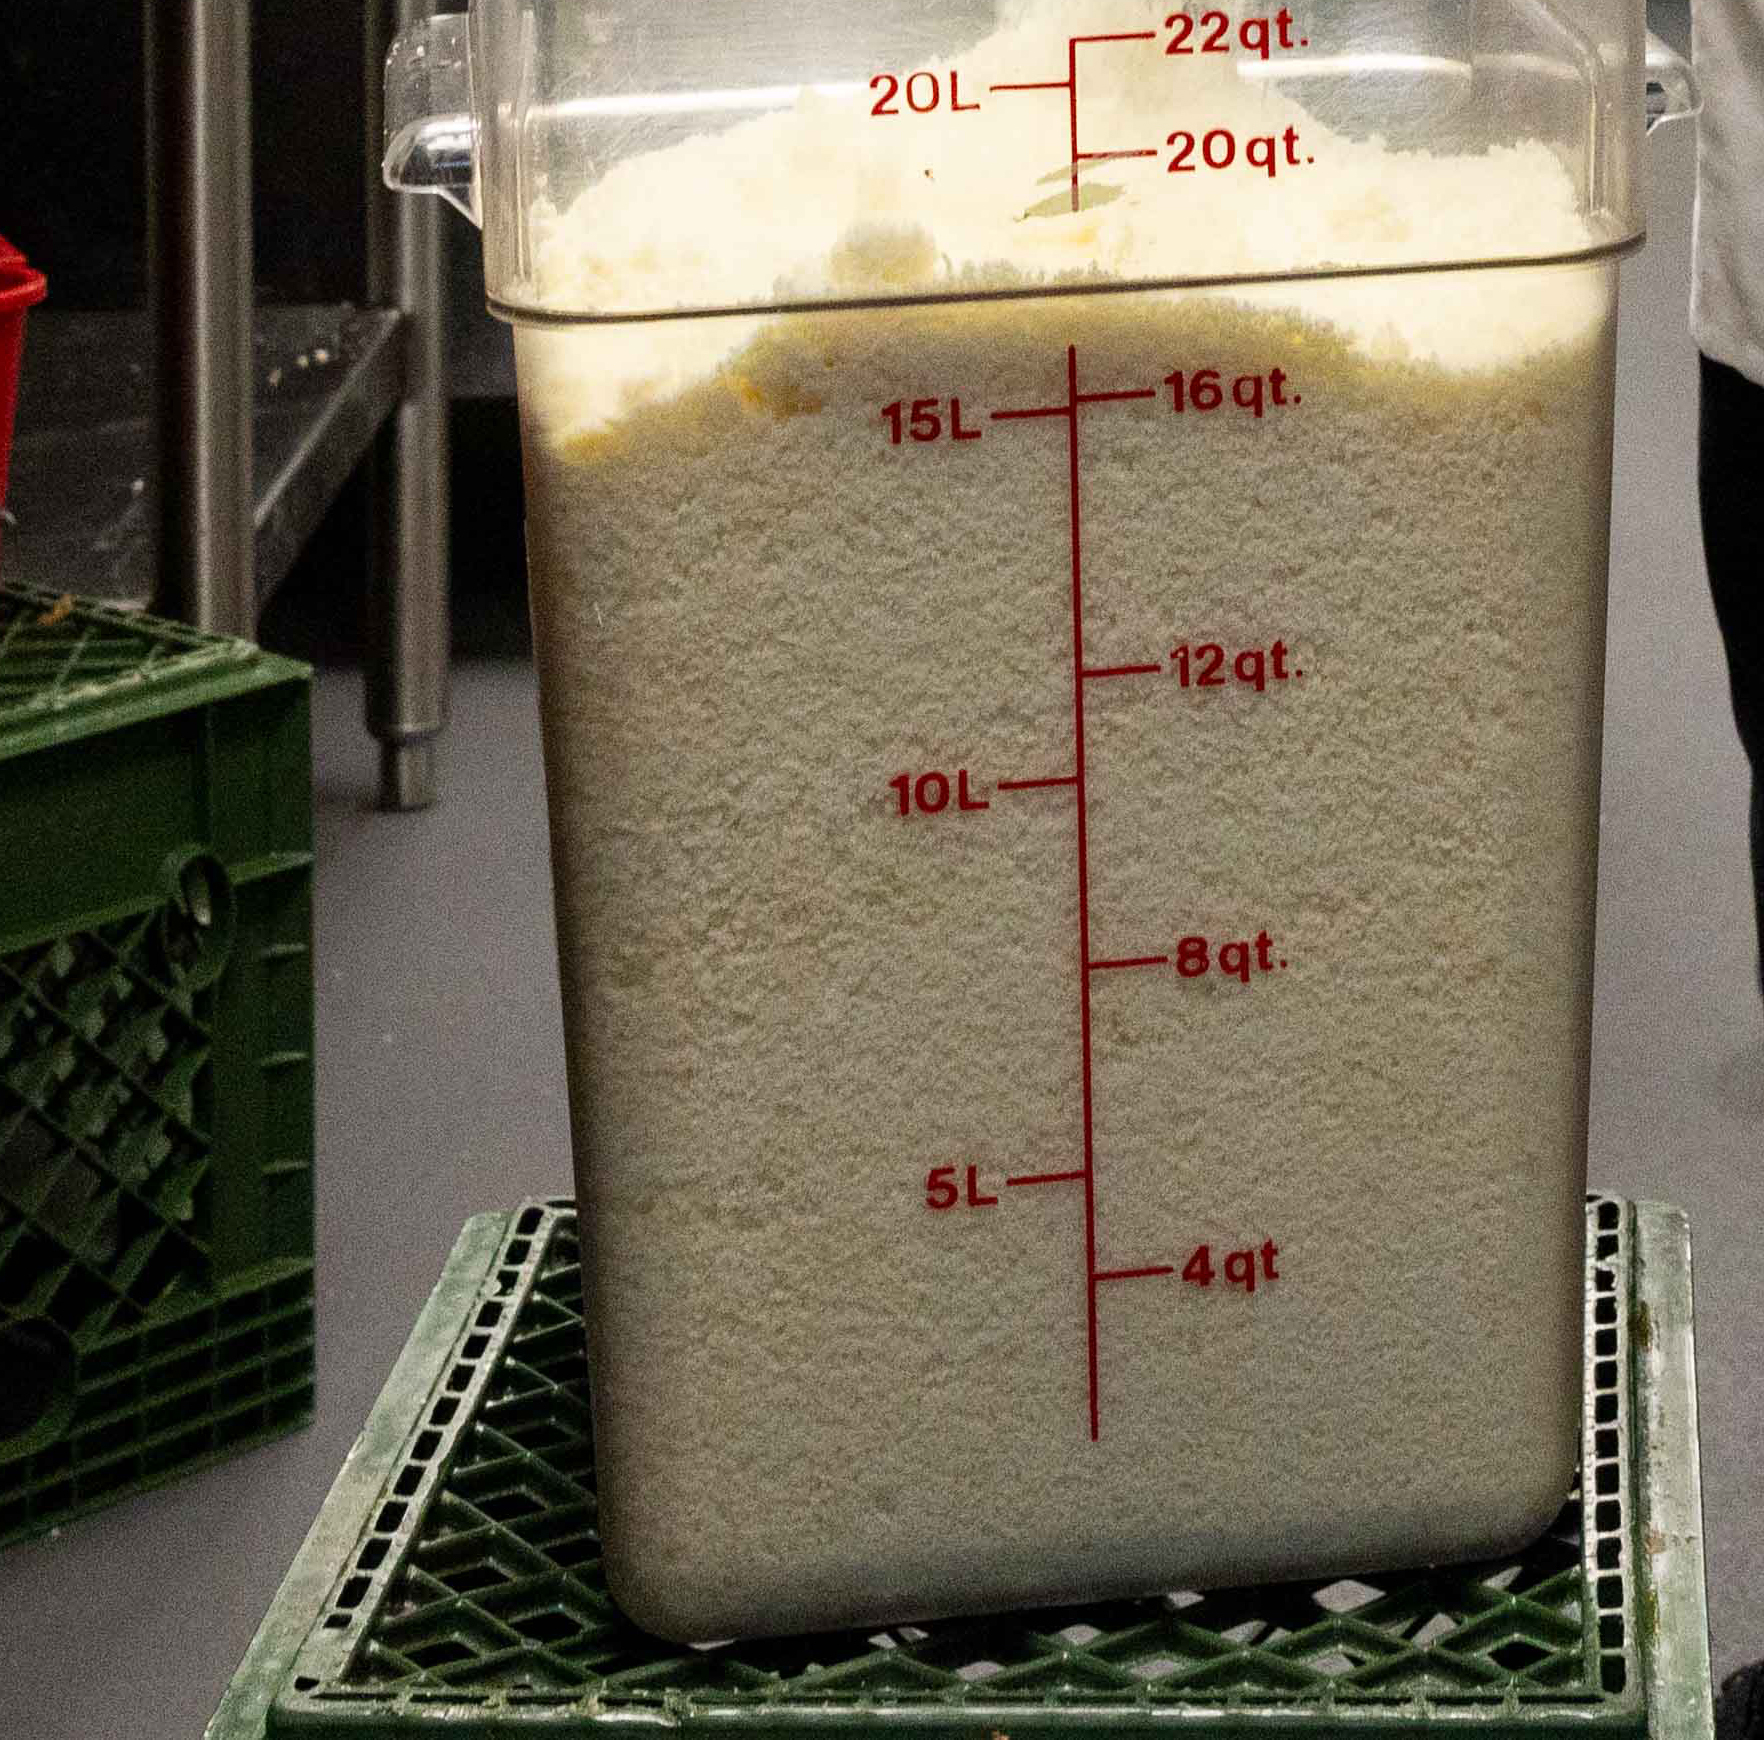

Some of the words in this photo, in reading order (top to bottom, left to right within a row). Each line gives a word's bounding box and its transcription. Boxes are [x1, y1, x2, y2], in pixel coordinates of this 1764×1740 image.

[869, 70, 981, 116] 20L
[880, 398, 982, 445] 15L
[889, 770, 989, 816] 10L
[926, 1164, 997, 1210] 5L
